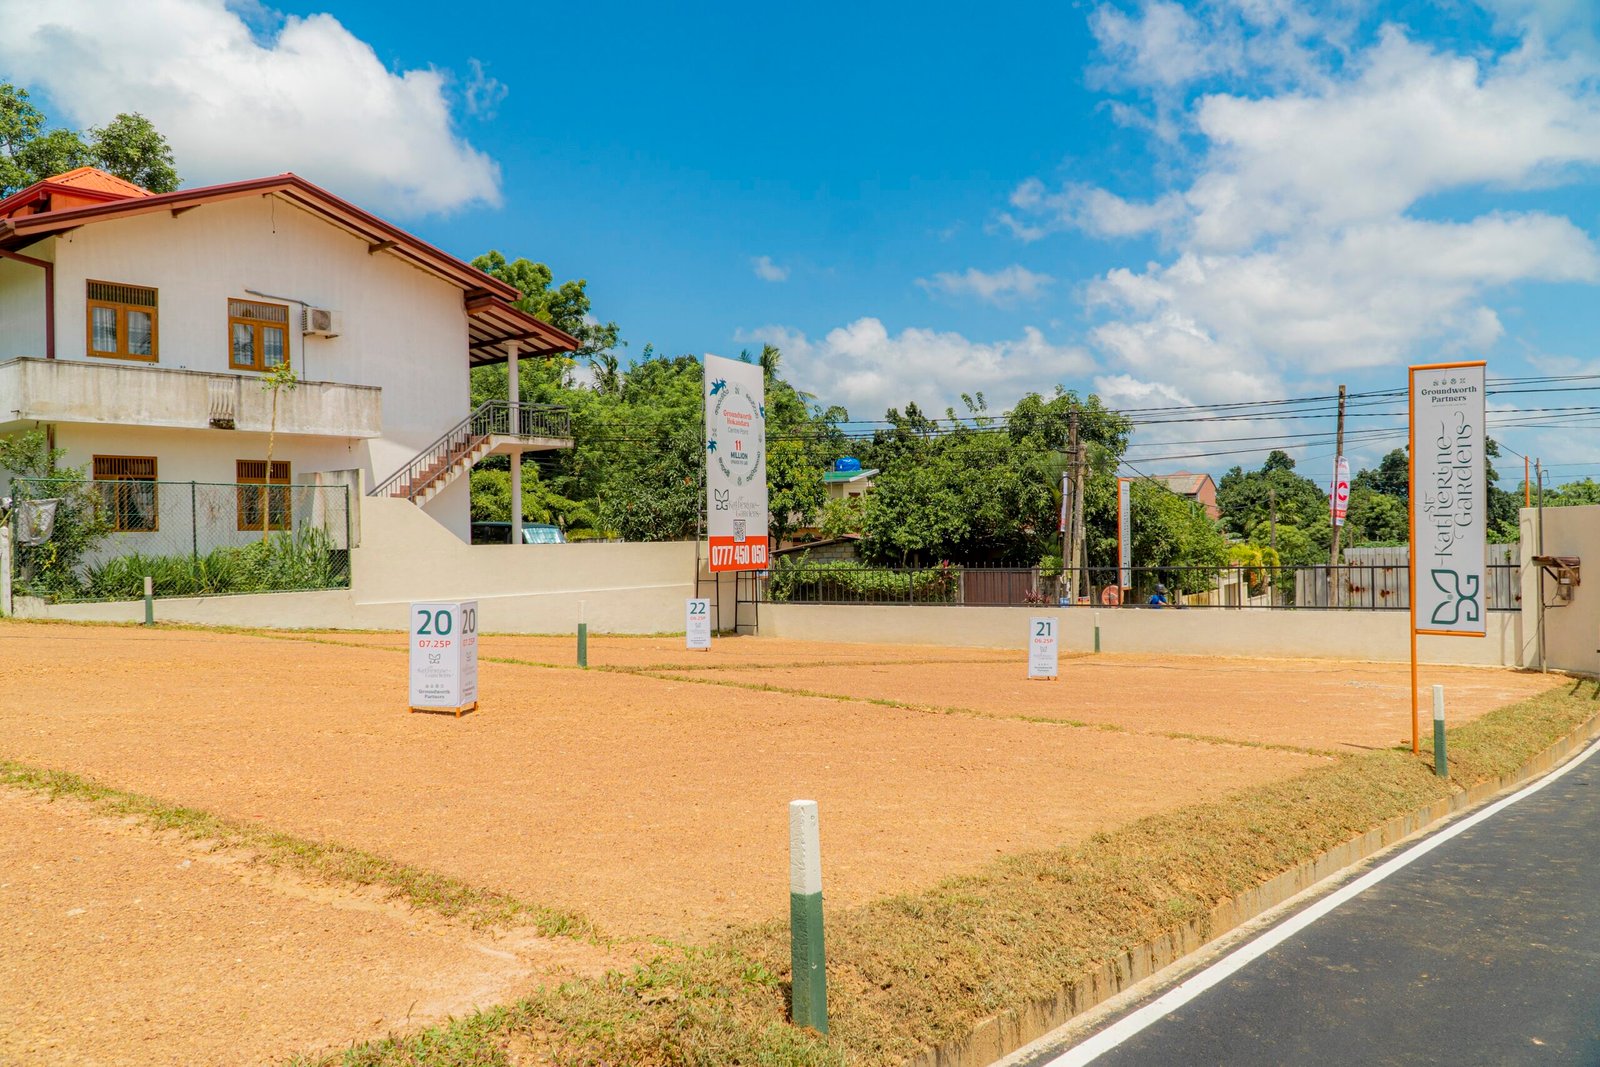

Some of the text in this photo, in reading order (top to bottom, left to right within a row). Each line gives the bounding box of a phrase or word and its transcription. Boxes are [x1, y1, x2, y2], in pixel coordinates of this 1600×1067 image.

[1421, 386, 1477, 396] Groundworth
[1432, 395, 1467, 403] Partners
[735, 440, 742, 451] 11
[731, 452, 748, 460] MILLION
[712, 544, 766, 566] 0777 450 050
[690, 602, 706, 615] 22
[417, 609, 452, 636] 20
[462, 608, 476, 635] 20
[1036, 621, 1051, 636] 21
[418, 640, 451, 648] 07.25P
